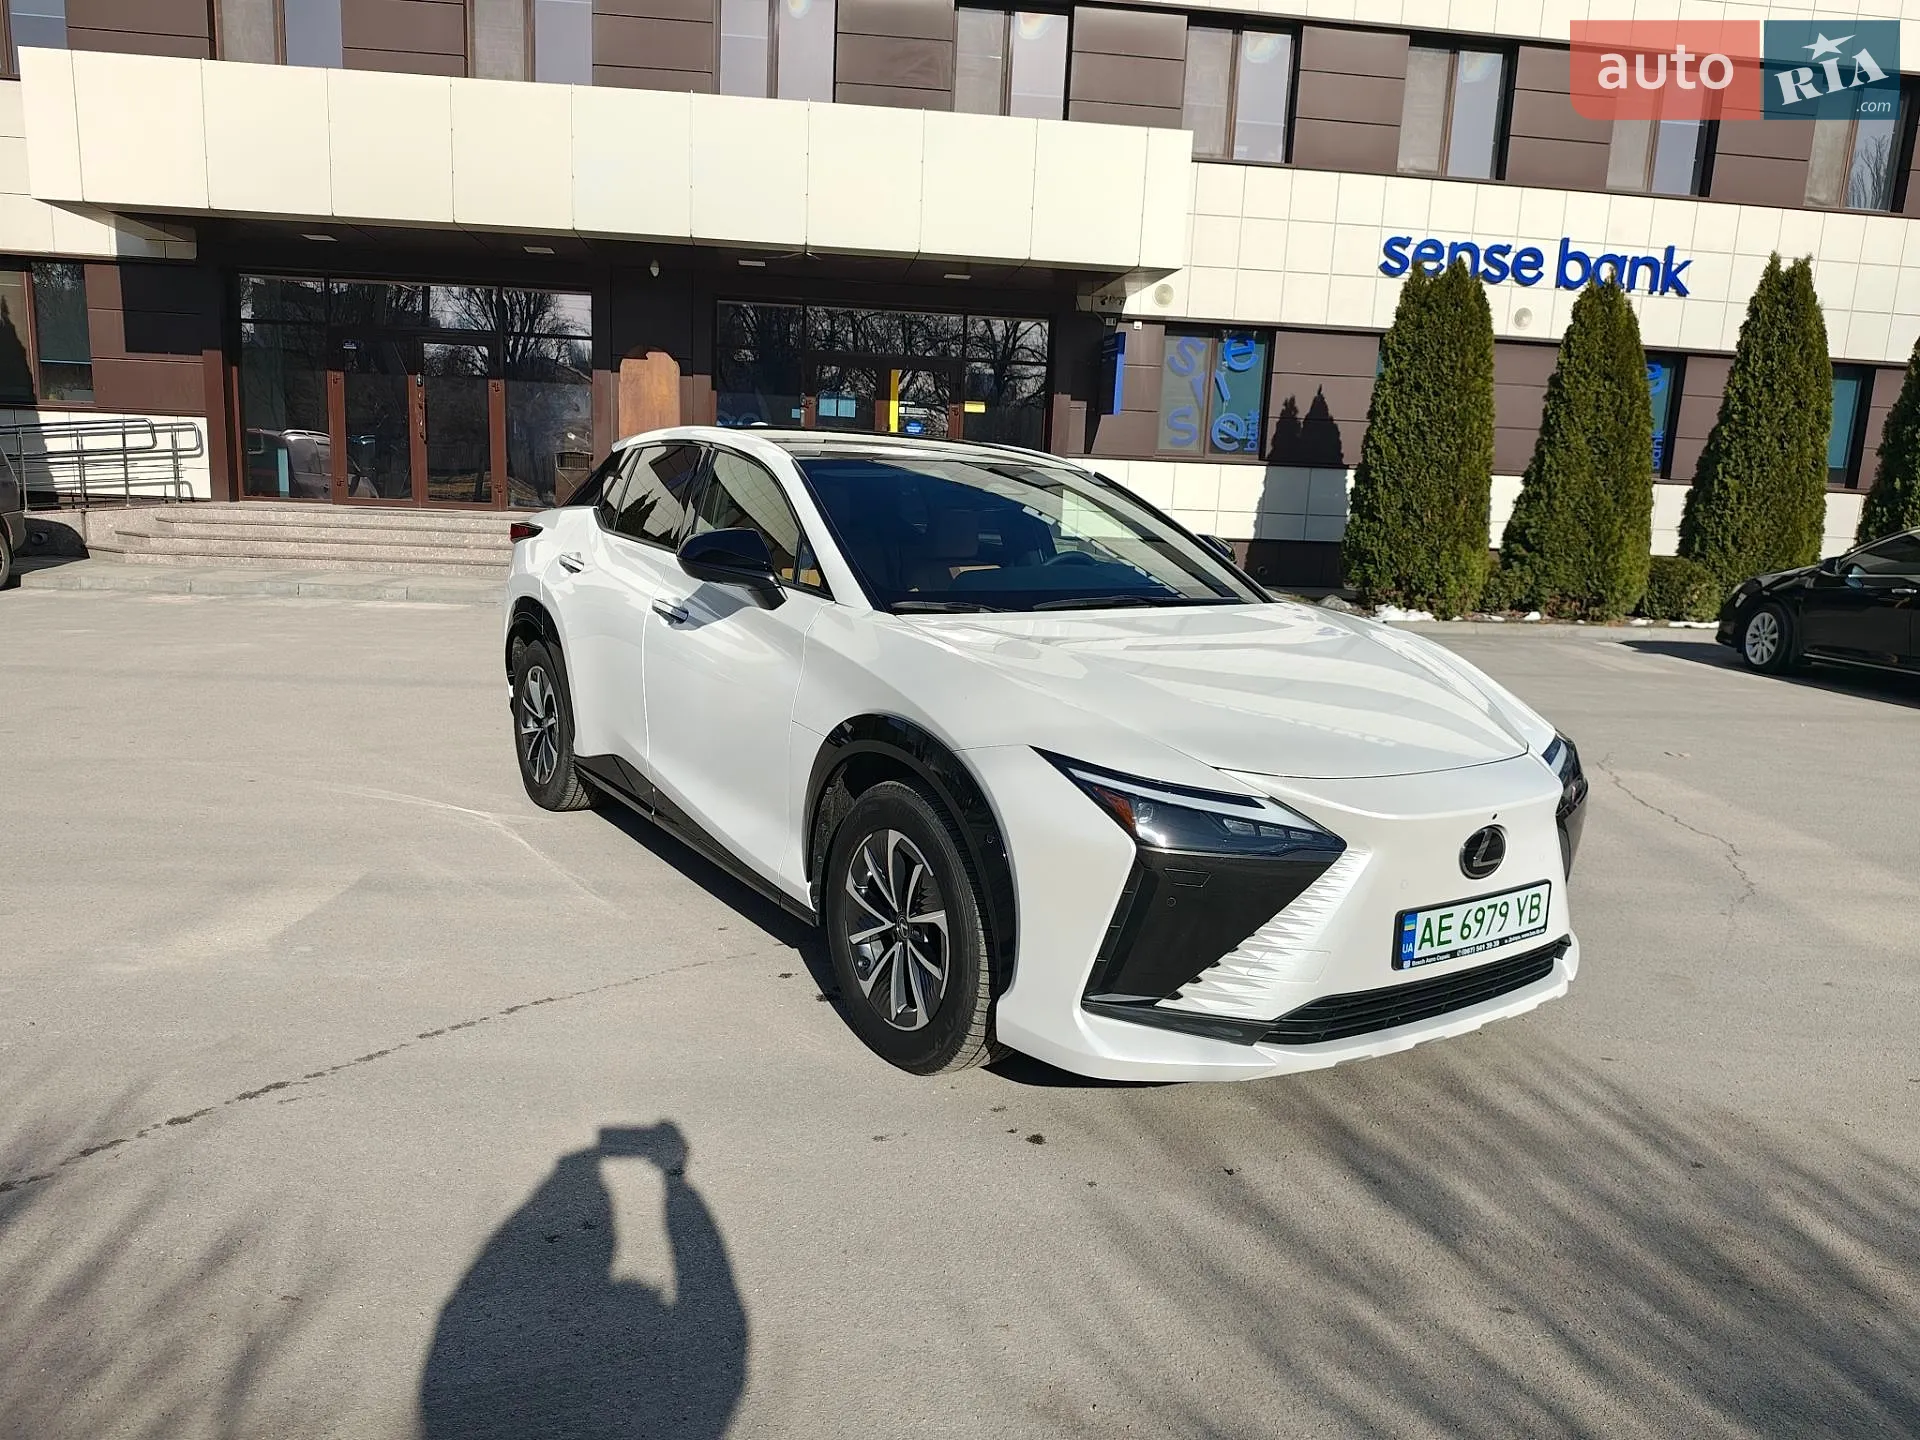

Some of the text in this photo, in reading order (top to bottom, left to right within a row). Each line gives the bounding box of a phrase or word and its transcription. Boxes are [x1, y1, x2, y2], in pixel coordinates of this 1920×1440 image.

[1379, 236, 1691, 296] sense bank
[1402, 942, 1414, 955] UA
[1417, 913, 1453, 950] AE
[1460, 901, 1509, 940] 6979
[1517, 893, 1541, 926] YB
